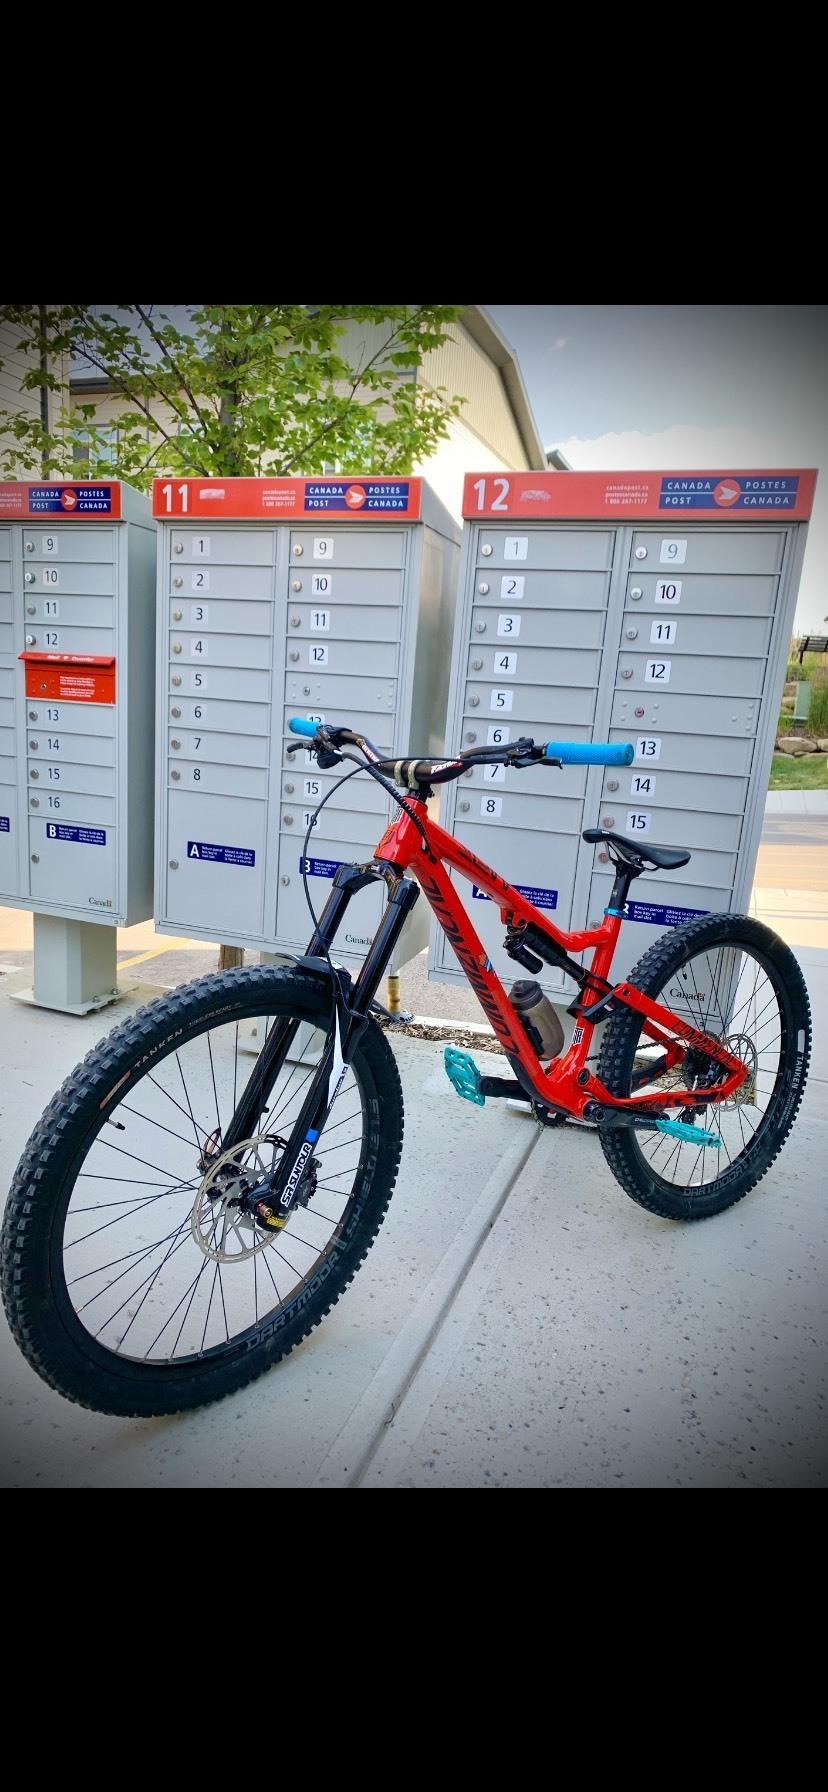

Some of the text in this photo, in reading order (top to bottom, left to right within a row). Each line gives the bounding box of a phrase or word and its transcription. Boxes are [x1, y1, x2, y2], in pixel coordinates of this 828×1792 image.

[309, 486, 401, 495] CANADA POSTES
[667, 481, 787, 490] CANADA POSTES
[162, 484, 188, 512] 11
[473, 478, 509, 511] 12
[743, 496, 790, 504] CANADA
[46, 538, 54, 551] 9
[319, 541, 328, 556] 9
[667, 543, 678, 559] 9
[45, 570, 58, 583] 10
[196, 573, 204, 587] 2
[316, 578, 328, 591] 10
[507, 580, 517, 594] 2
[660, 584, 677, 600] 10
[46, 601, 57, 614] 11
[196, 607, 203, 621] 3
[315, 613, 326, 627] 11
[506, 618, 513, 632] 3
[656, 624, 671, 640] 11
[46, 633, 58, 646] 12
[194, 640, 203, 654] 4
[313, 647, 325, 661] 12
[499, 656, 509, 670] 4
[650, 663, 666, 679] 12
[195, 673, 202, 687] 5
[496, 693, 505, 707] 5
[47, 709, 59, 722] 13
[194, 705, 202, 719] 6
[493, 729, 502, 743] 6
[47, 738, 60, 751] 14
[194, 737, 201, 750] 7
[640, 740, 657, 756] 13
[48, 767, 60, 780] 15
[193, 768, 201, 781] 8
[489, 764, 500, 779] 7
[306, 781, 319, 795] 15
[634, 777, 651, 793] 14
[48, 796, 61, 809] 16
[486, 799, 496, 813] 8
[630, 814, 647, 829] 15
[49, 824, 57, 837] B
[190, 844, 199, 857] A
[670, 988, 705, 1002] Canada
[134, 1028, 183, 1068] TANKEN
[791, 1055, 804, 1089] TANKEN
[281, 1143, 312, 1207] SR SUNTOUR
[683, 1165, 744, 1197] DARTMOOR
[246, 1251, 340, 1352] DARTMOOR
